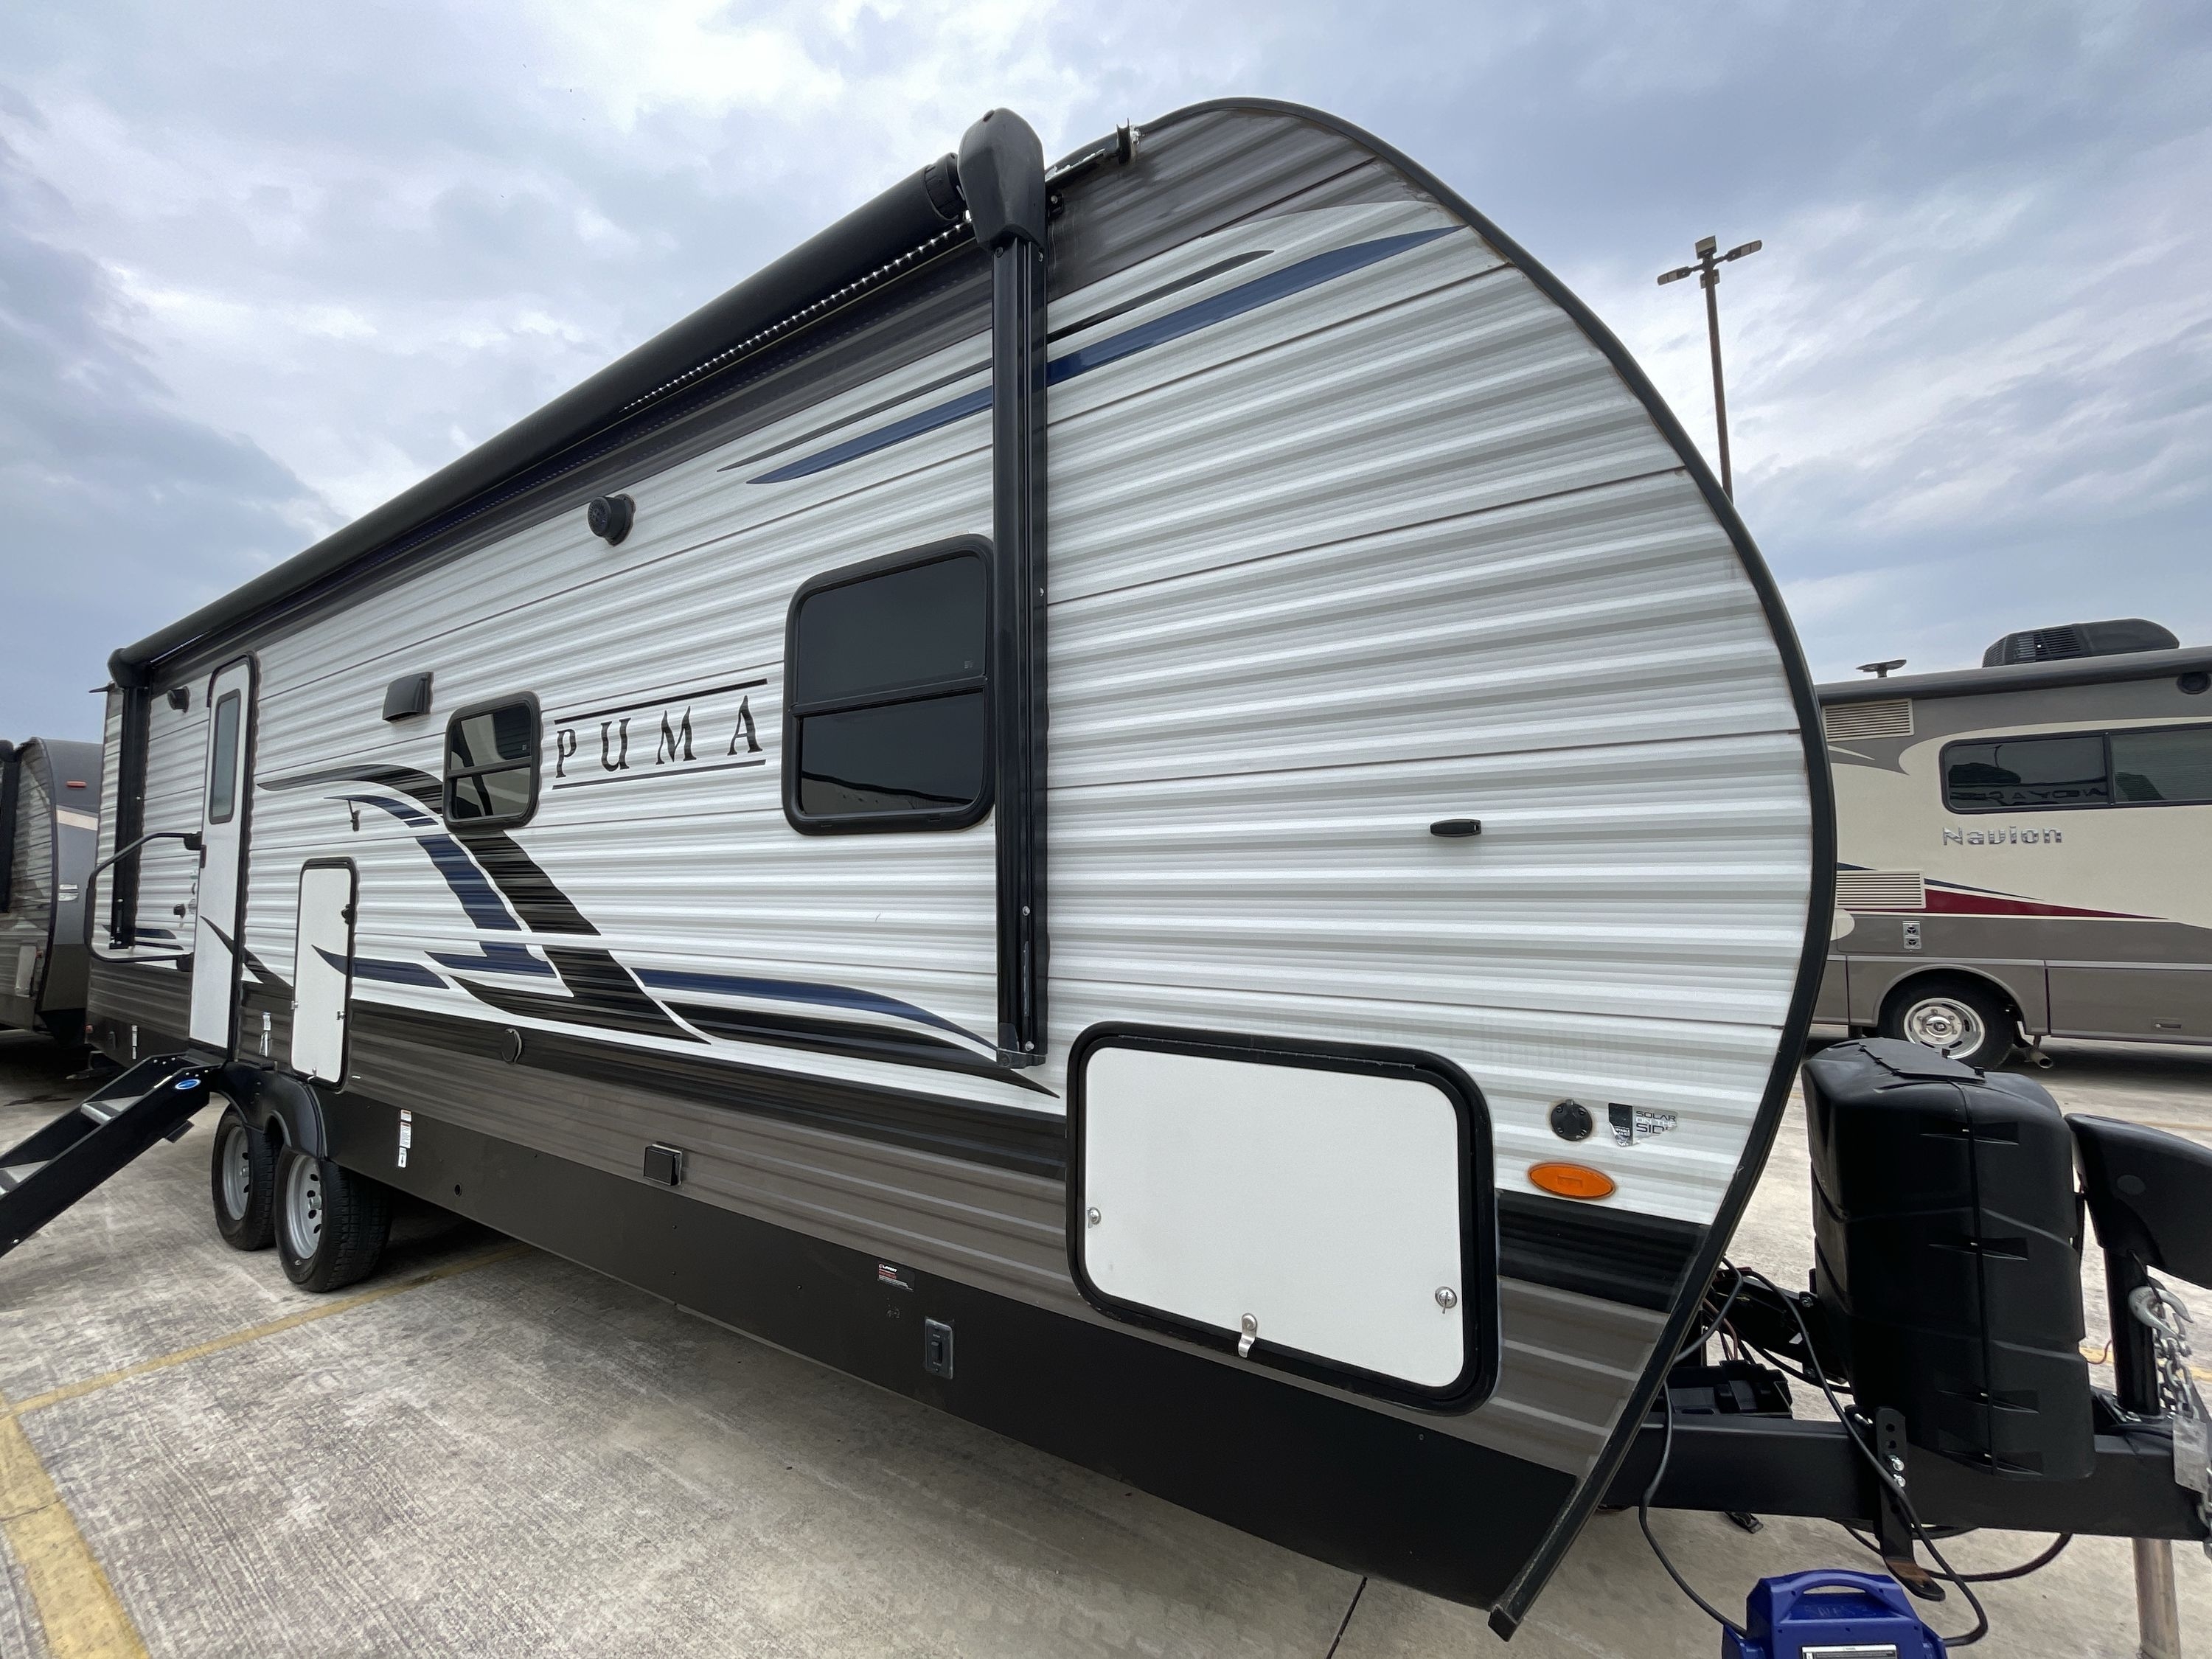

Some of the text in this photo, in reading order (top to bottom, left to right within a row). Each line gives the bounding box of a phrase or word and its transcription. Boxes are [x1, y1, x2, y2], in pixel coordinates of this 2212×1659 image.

[555, 695, 764, 779] PUMA
[1942, 825, 2063, 846] Navion
[1636, 1111, 1676, 1121] SOLAR
[1636, 1123, 1668, 1134] SID
